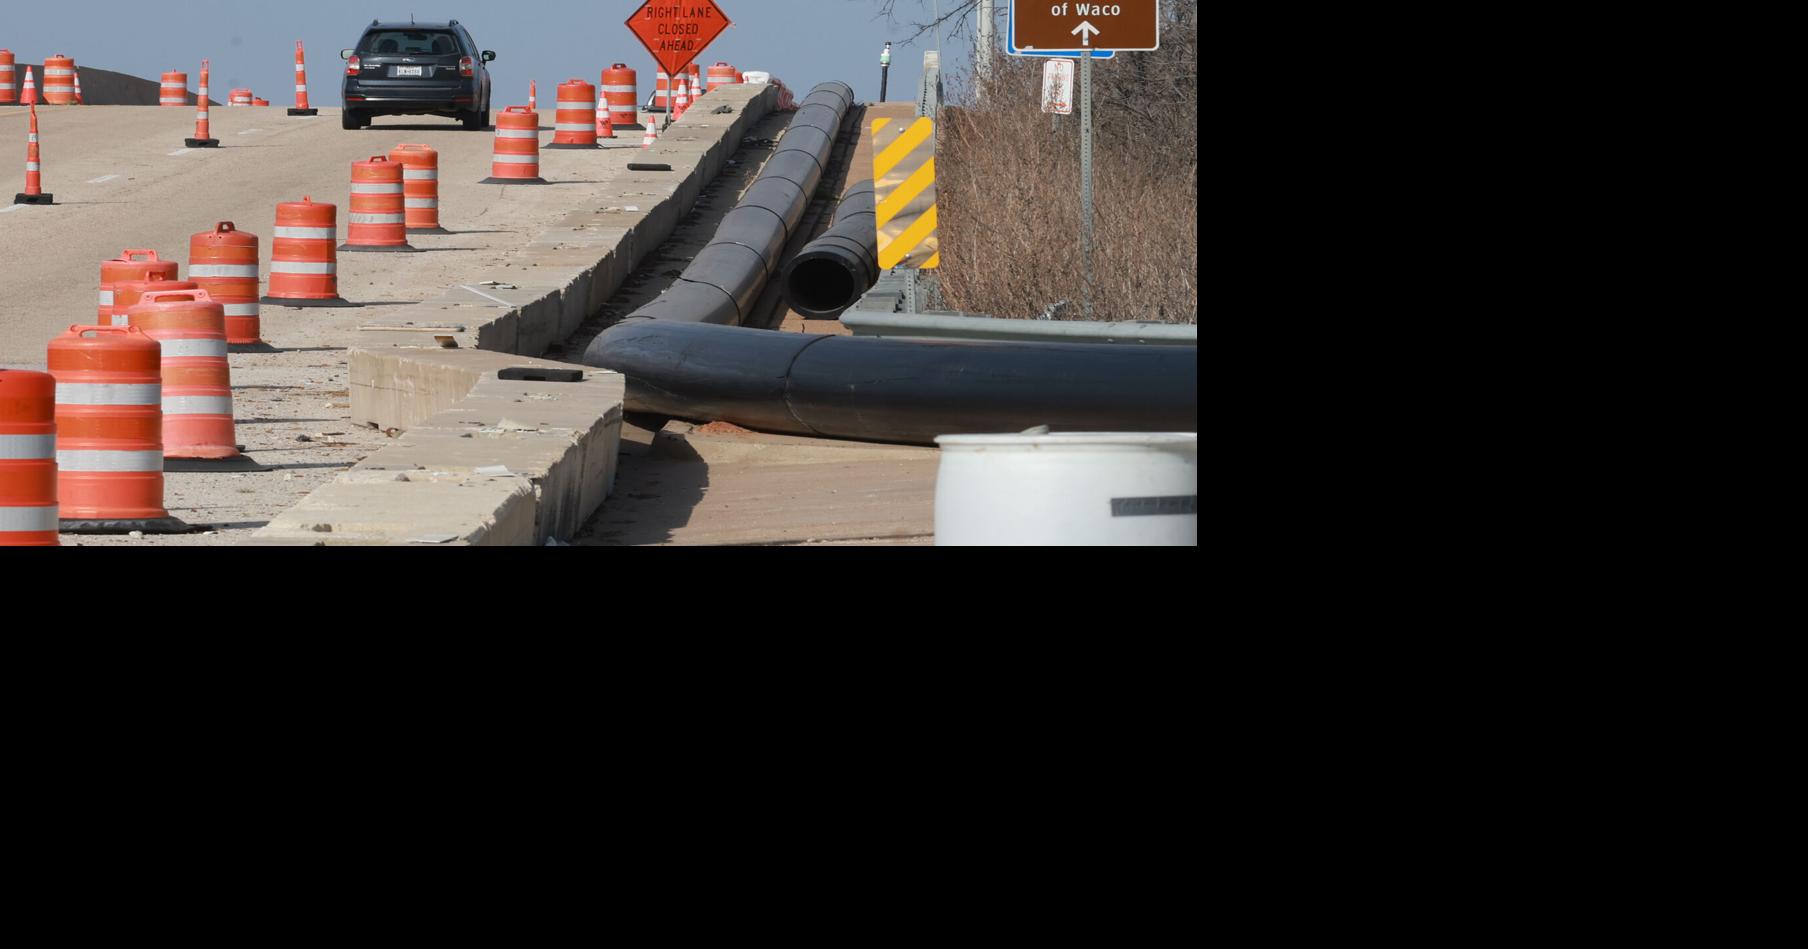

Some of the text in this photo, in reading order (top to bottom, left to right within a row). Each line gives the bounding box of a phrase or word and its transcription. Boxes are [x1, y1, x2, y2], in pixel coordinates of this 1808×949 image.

[646, 6, 711, 18] RIGHT LANE
[1051, 2, 1121, 16] of Waco
[657, 23, 699, 35] CLOSED
[659, 40, 694, 51] AHEAD
